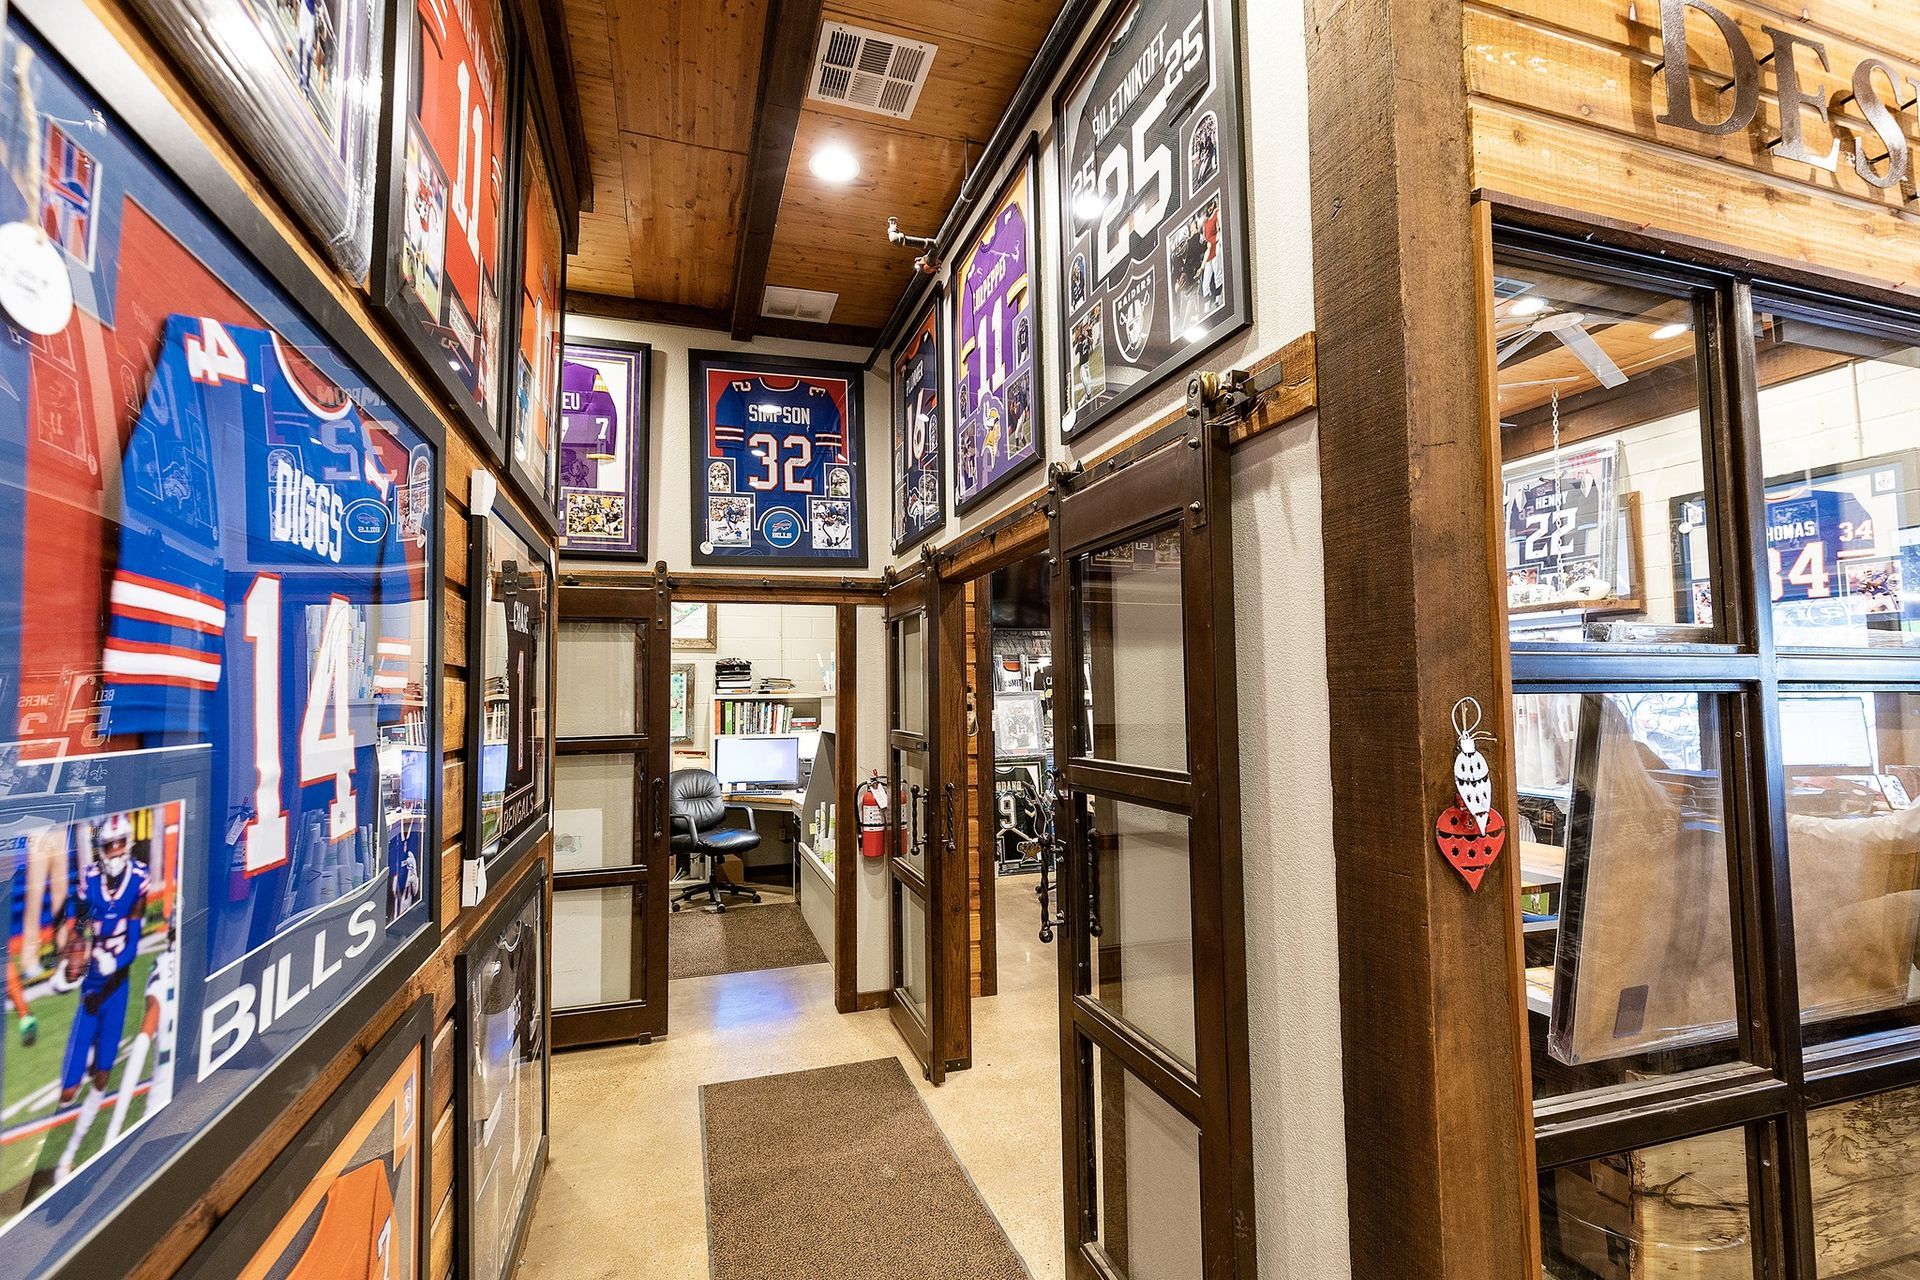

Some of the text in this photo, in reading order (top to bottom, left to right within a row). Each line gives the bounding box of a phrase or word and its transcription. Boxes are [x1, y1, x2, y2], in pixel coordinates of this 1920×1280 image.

[1164, 10, 1203, 99] 25
[1657, 0, 1920, 202] DES
[452, 59, 484, 263] 11
[1097, 85, 1172, 282] 25
[1117, 274, 1152, 312] RAIDERS
[977, 295, 1006, 408] 11
[595, 417, 610, 440] 7
[748, 404, 811, 425] SIMPSON
[748, 433, 813, 493] 32
[274, 459, 344, 563] DIGGS
[1525, 507, 1578, 560] 22
[1767, 521, 1816, 542] HOMAS
[1839, 518, 1874, 543] 34
[243, 571, 357, 880] 14
[502, 793, 535, 836] BENGALS
[995, 781, 1022, 793] ODANO
[998, 794, 1017, 829] 9
[197, 900, 377, 1084] BILLS
